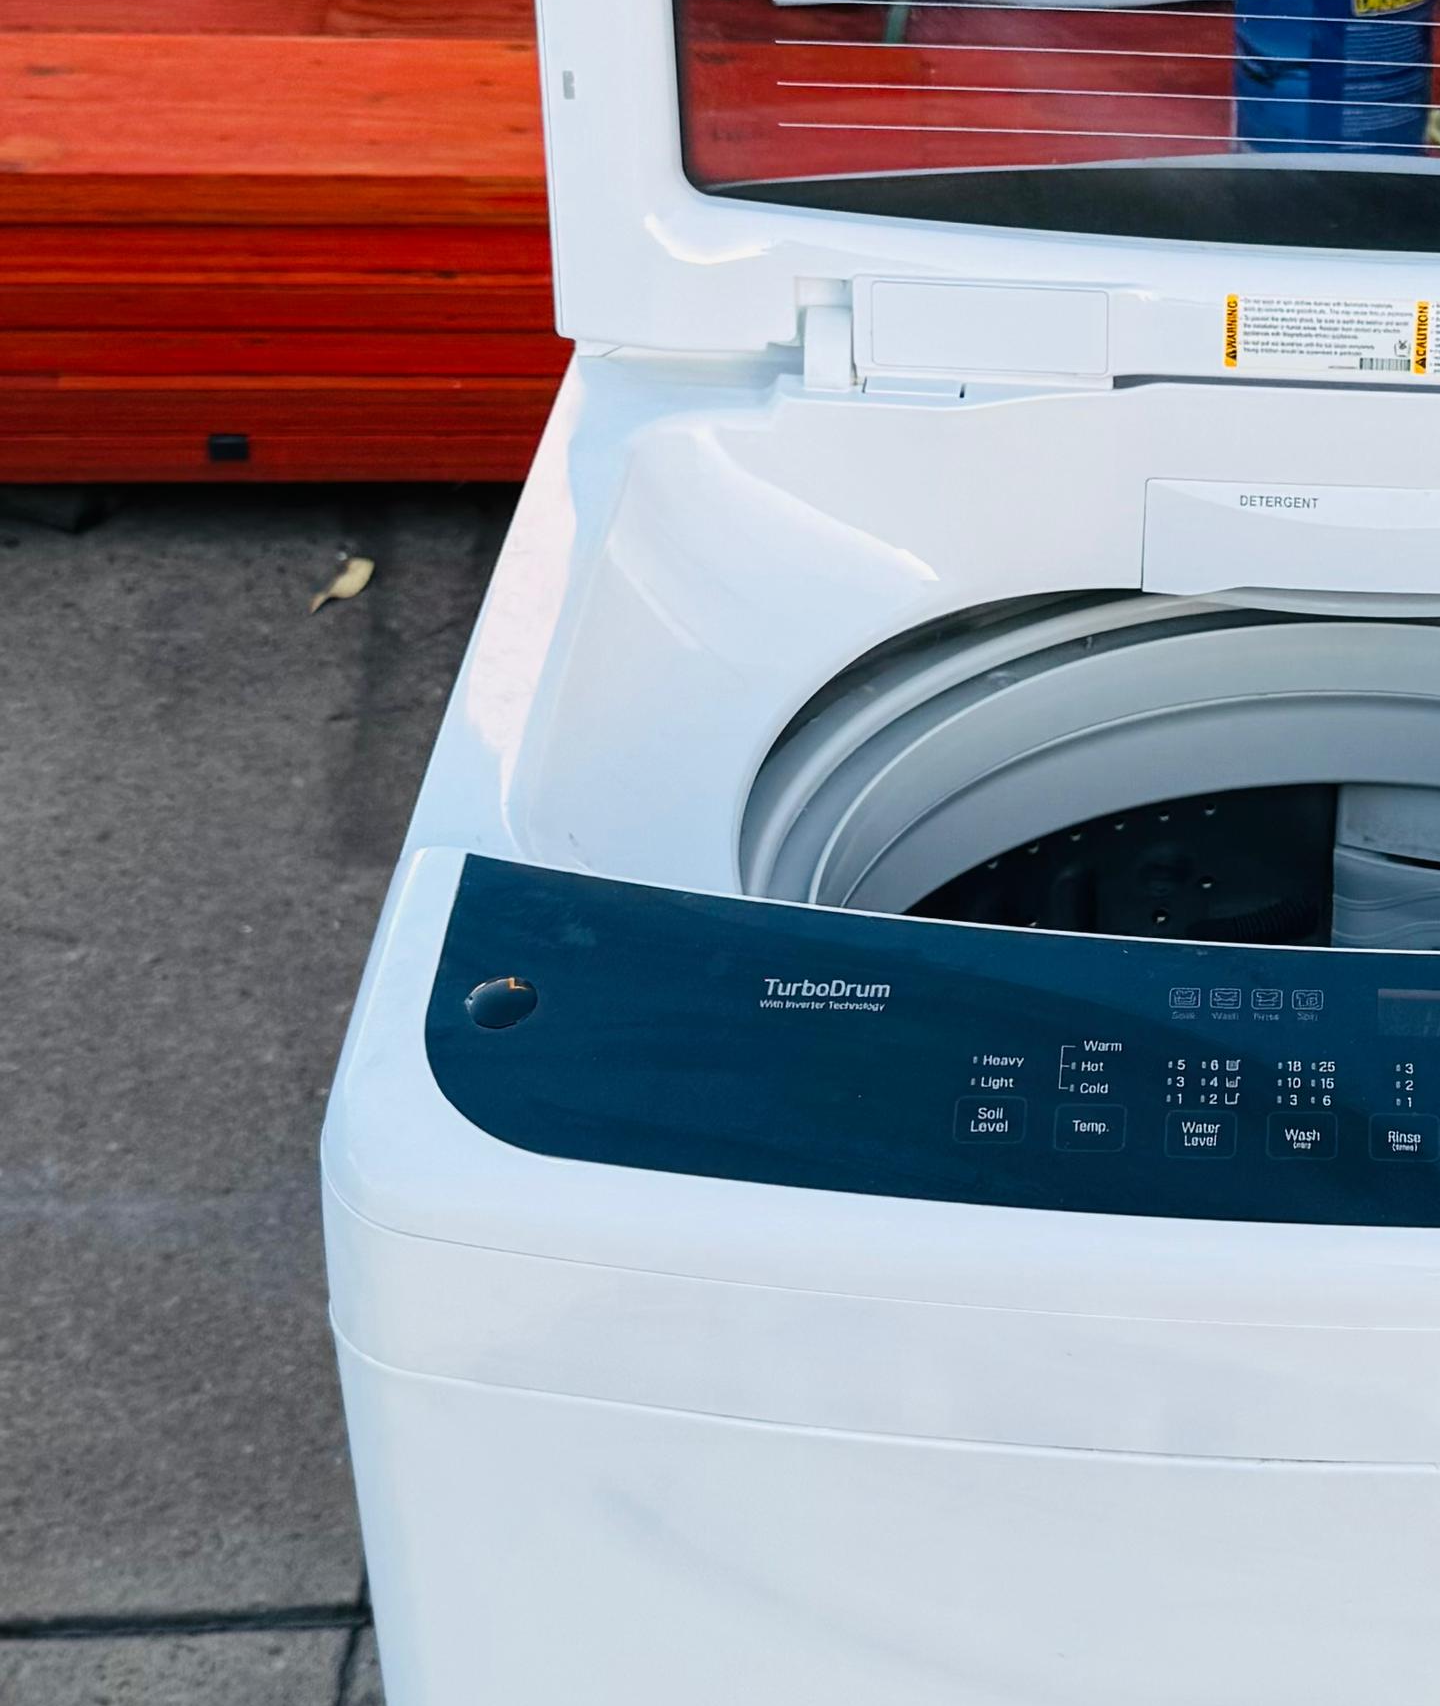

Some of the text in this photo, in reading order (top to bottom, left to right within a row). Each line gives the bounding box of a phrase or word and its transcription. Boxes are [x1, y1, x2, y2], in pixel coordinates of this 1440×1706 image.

[1416, 305, 1428, 356] CAUTION
[1239, 495, 1319, 509] DETERGENT
[764, 978, 892, 998] TurboDrum
[759, 1000, 886, 1012] With Inverter Technology
[1083, 1040, 1123, 1052] Warm
[982, 1054, 1025, 1067] Heavy
[1081, 1061, 1104, 1072] Hot
[1176, 1059, 1219, 1070] 5 6
[1287, 1060, 1336, 1072] 18 25
[1404, 1062, 1414, 1074] 3
[980, 1077, 1014, 1090] Light
[1176, 1076, 1218, 1087] 3 4
[1287, 1077, 1335, 1089] 10 15
[1404, 1079, 1414, 1091] 2
[1079, 1082, 1109, 1094] Cold
[1208, 1094, 1218, 1105] 2
[1289, 1094, 1332, 1106] 3 6
[1406, 1096, 1413, 1108] 1
[977, 1107, 1004, 1120] Soil
[970, 1120, 1009, 1133] Level
[1072, 1119, 1110, 1135] Temp.
[1181, 1121, 1221, 1134] Water
[1184, 1134, 1218, 1147] Level
[1284, 1128, 1321, 1142] Wash
[1387, 1130, 1422, 1143] Rinse
